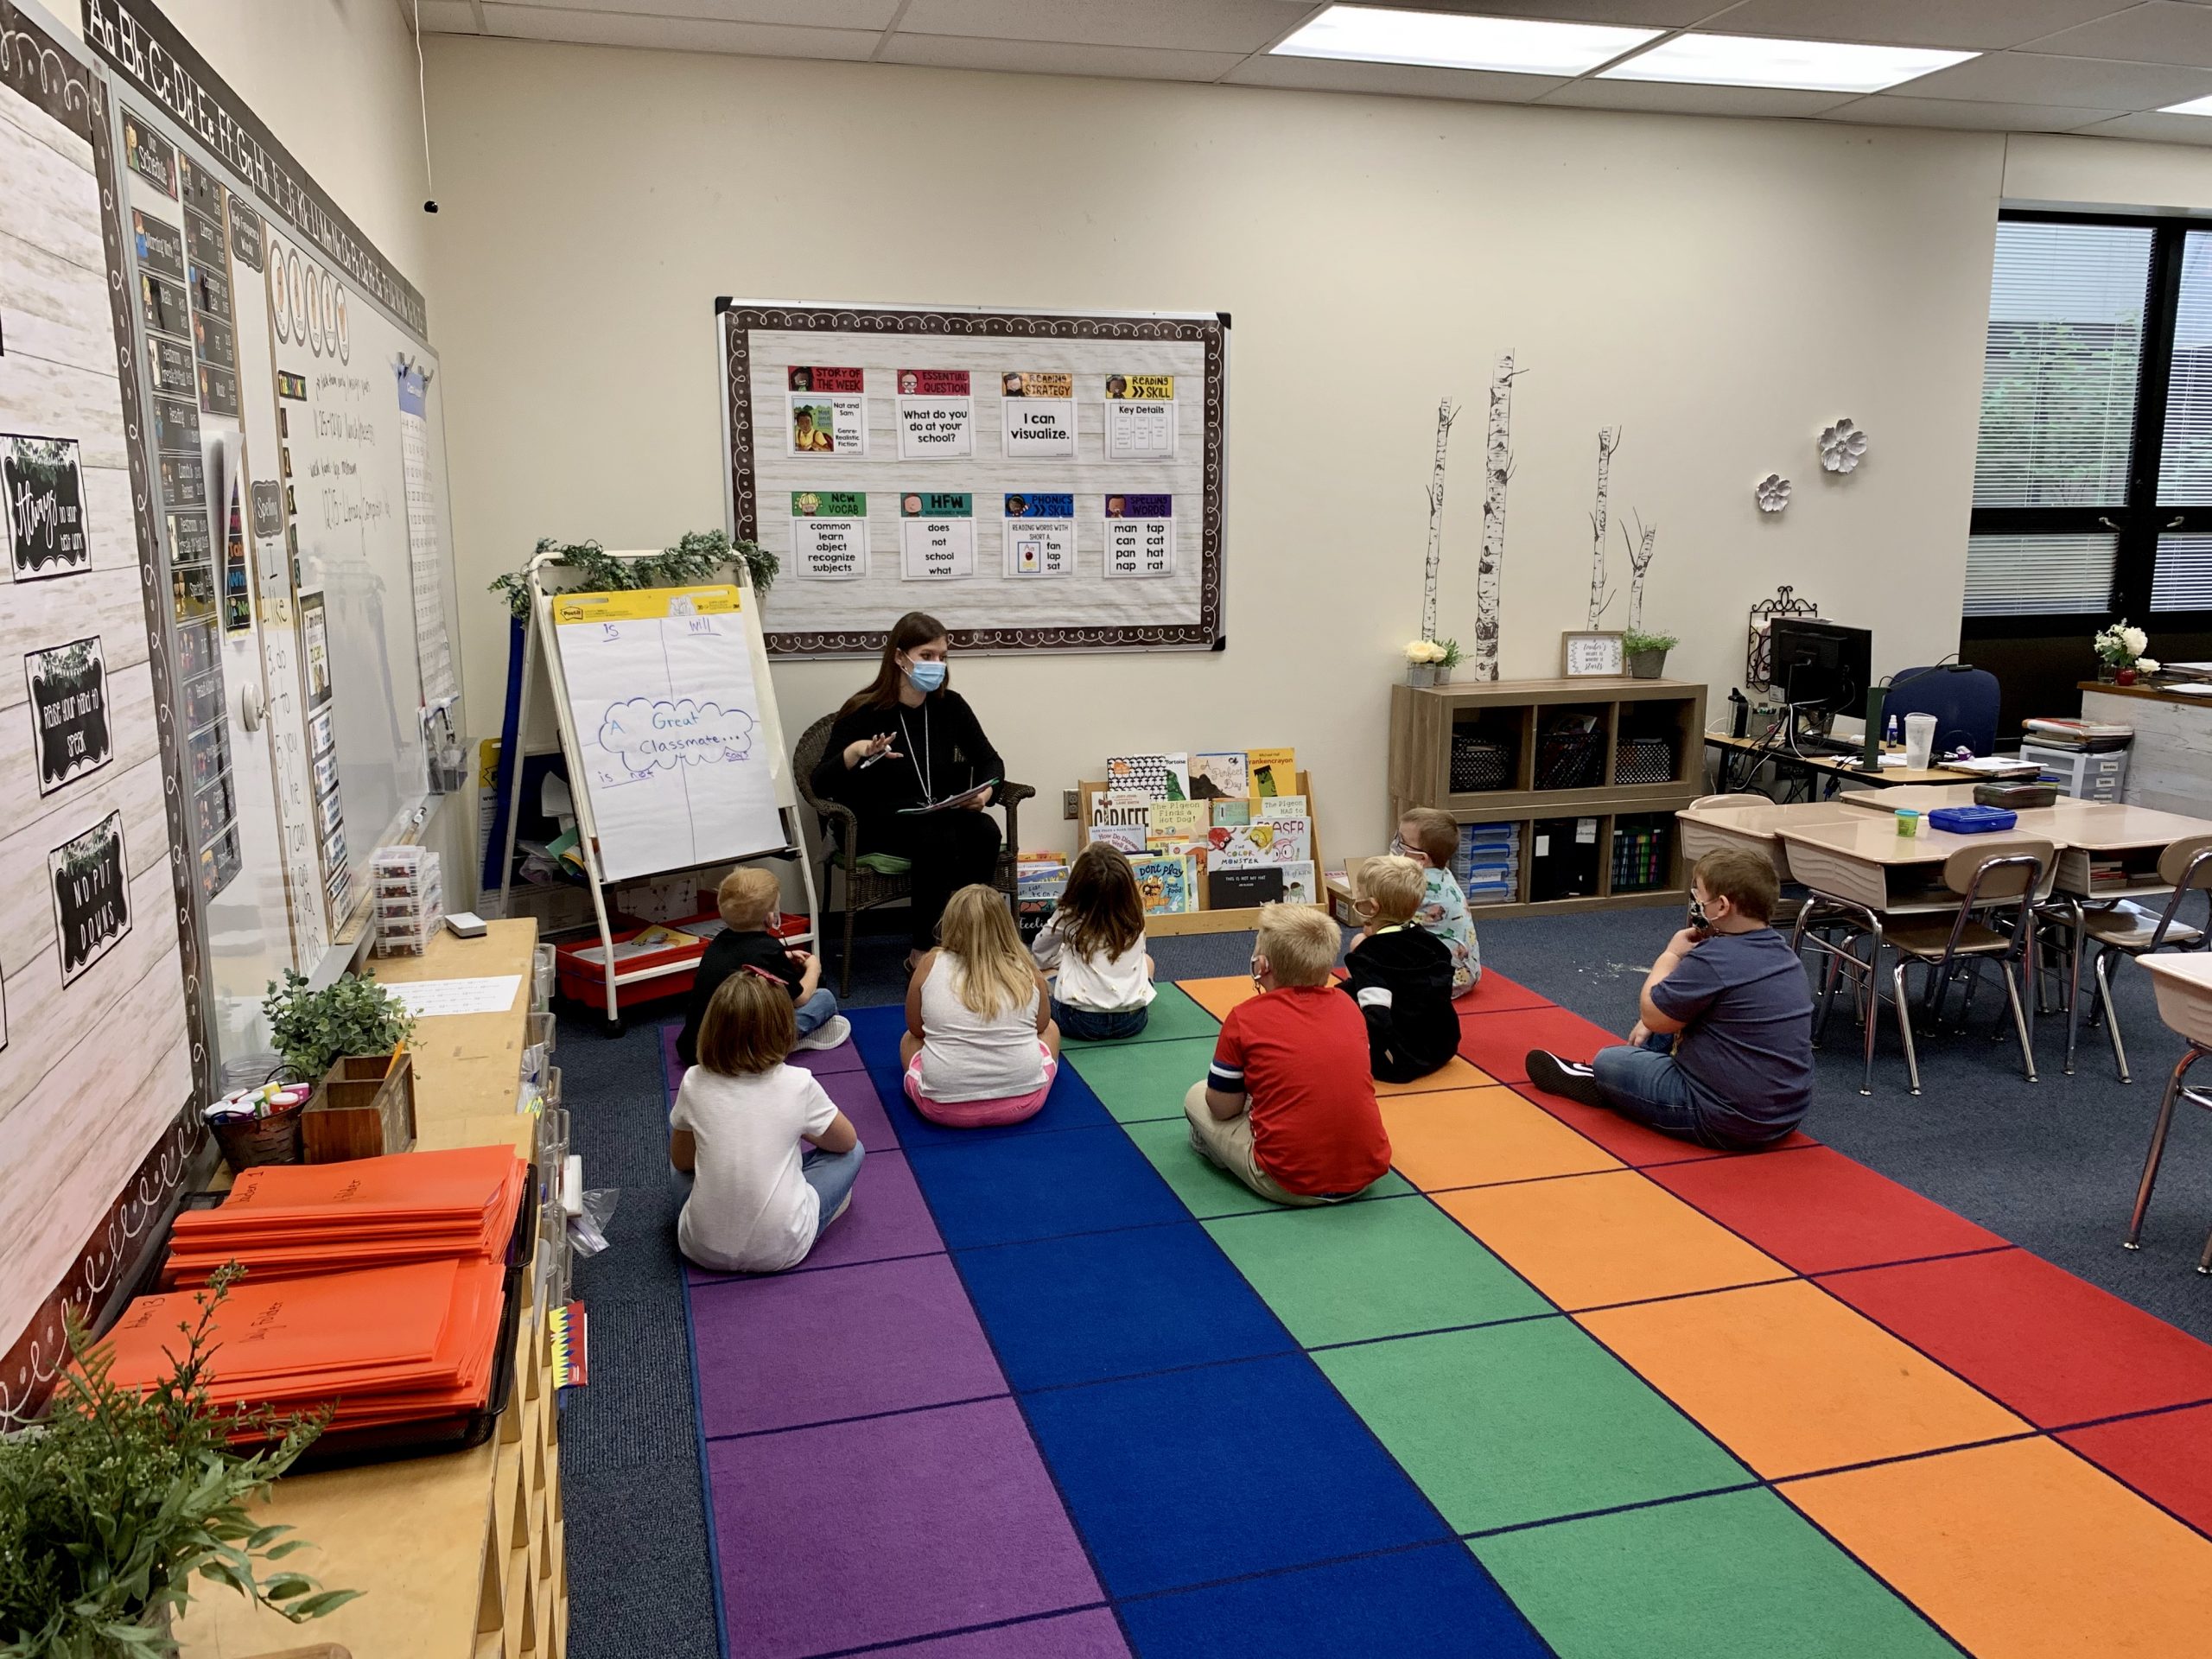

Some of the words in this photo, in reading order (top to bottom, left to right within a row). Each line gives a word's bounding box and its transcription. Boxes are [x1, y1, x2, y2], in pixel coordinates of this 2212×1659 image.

[118, 4, 145, 82] Bb
[149, 40, 172, 105] Cc
[173, 60, 194, 129] Dd
[197, 86, 214, 145] Ee
[217, 106, 232, 162] Ff
[237, 127, 256, 194] Gg
[253, 142, 269, 192] Hh
[138, 145, 168, 185] Schedule
[817, 368, 846, 378] STORY
[849, 369, 861, 378] OF
[923, 372, 968, 382] ESSENTIAL
[817, 379, 835, 390] THE
[836, 380, 861, 391] WEEK
[924, 383, 968, 394] QUESTION
[1025, 385, 1071, 397] STRATEGY
[1146, 387, 1171, 398] SKILL
[904, 410, 930, 420] What
[933, 410, 946, 419] do
[950, 410, 968, 423] you
[1119, 406, 1134, 416] Key
[1024, 414, 1027, 423] I
[1031, 415, 1055, 424] can
[910, 423, 922, 431] do
[925, 423, 937, 431] at
[939, 423, 963, 434] your
[1010, 428, 1070, 440] visualize.
[918, 433, 956, 442] school?
[931, 494, 963, 509] HFW
[16, 480, 58, 549] Always
[257, 497, 278, 523] Spelling
[829, 504, 859, 514] VOCAB
[1048, 505, 1073, 516] SKILL
[1132, 505, 1166, 516] WORDS
[928, 524, 950, 532] does
[1114, 524, 1137, 533] man
[1147, 524, 1165, 535] tap
[819, 532, 843, 541] learn
[1116, 537, 1135, 545] can
[1147, 537, 1164, 545] cat
[817, 543, 847, 552] object
[808, 553, 855, 563] recognize
[925, 552, 955, 561] school
[1047, 552, 1060, 561] lap
[1116, 550, 1135, 560] pan
[1147, 549, 1164, 557] hat
[813, 563, 852, 574] subjects
[1116, 562, 1136, 572] nap
[1147, 561, 1164, 569] rat
[269, 586, 288, 626] like
[276, 632, 286, 670] do
[280, 677, 290, 714] to
[610, 720, 626, 735] A
[652, 712, 700, 729] Great
[283, 733, 299, 775] you
[600, 772, 613, 783] is
[631, 770, 654, 779] not
[1211, 767, 1243, 780] Perfect
[286, 760, 301, 805] he
[1224, 779, 1242, 791] Day
[294, 822, 308, 853] can
[73, 876, 90, 908] NO
[93, 859, 111, 894] PUT
[80, 901, 114, 950] DOWNS
[1020, 917, 1046, 929] Feeli
